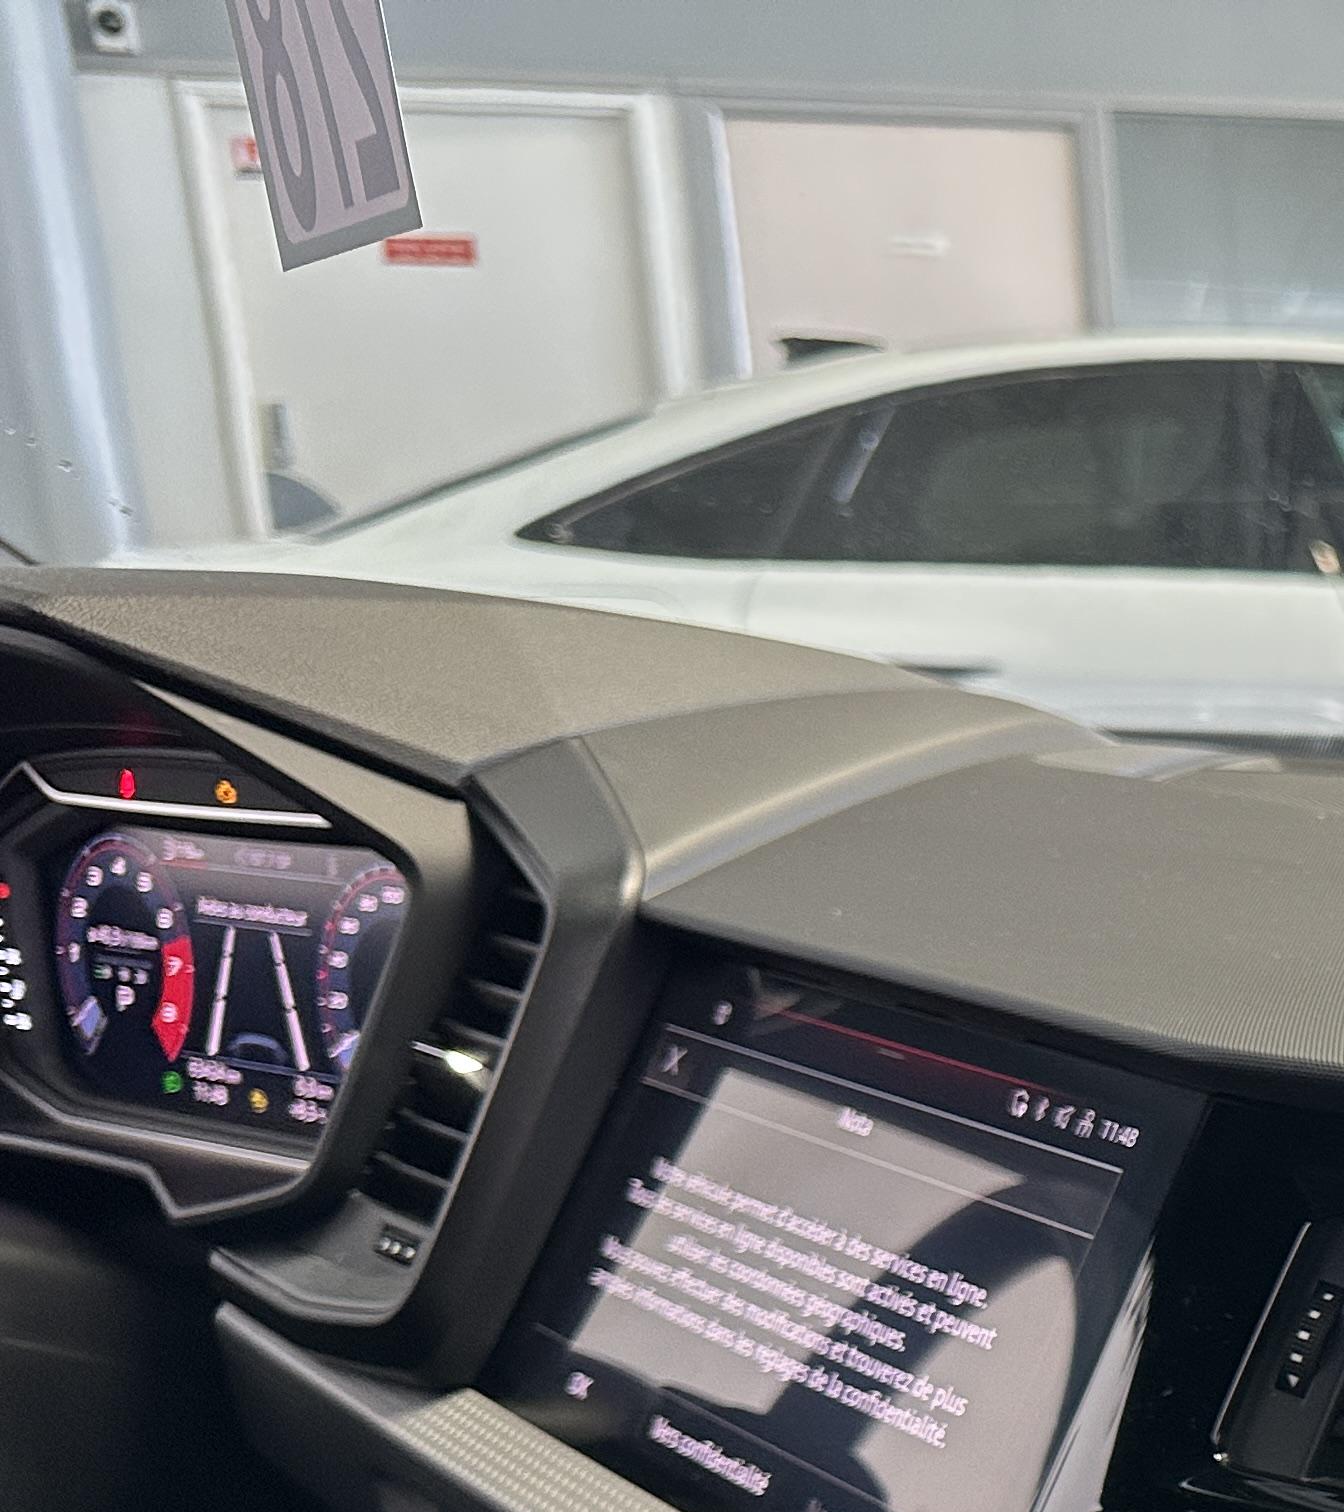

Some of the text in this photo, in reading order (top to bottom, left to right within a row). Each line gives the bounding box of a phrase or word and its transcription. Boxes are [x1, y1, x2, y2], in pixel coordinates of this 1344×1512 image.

[1099, 1118, 1140, 1148] 11:48
[834, 1268, 868, 1296] sont
[866, 1276, 920, 1316] activés
[931, 1308, 996, 1354] peuvent
[870, 1246, 928, 1283] services
[944, 1271, 992, 1313] ligne.
[840, 1378, 951, 1447] confidentialité.
[844, 1347, 913, 1392] trouverez
[932, 1380, 969, 1420] plus
